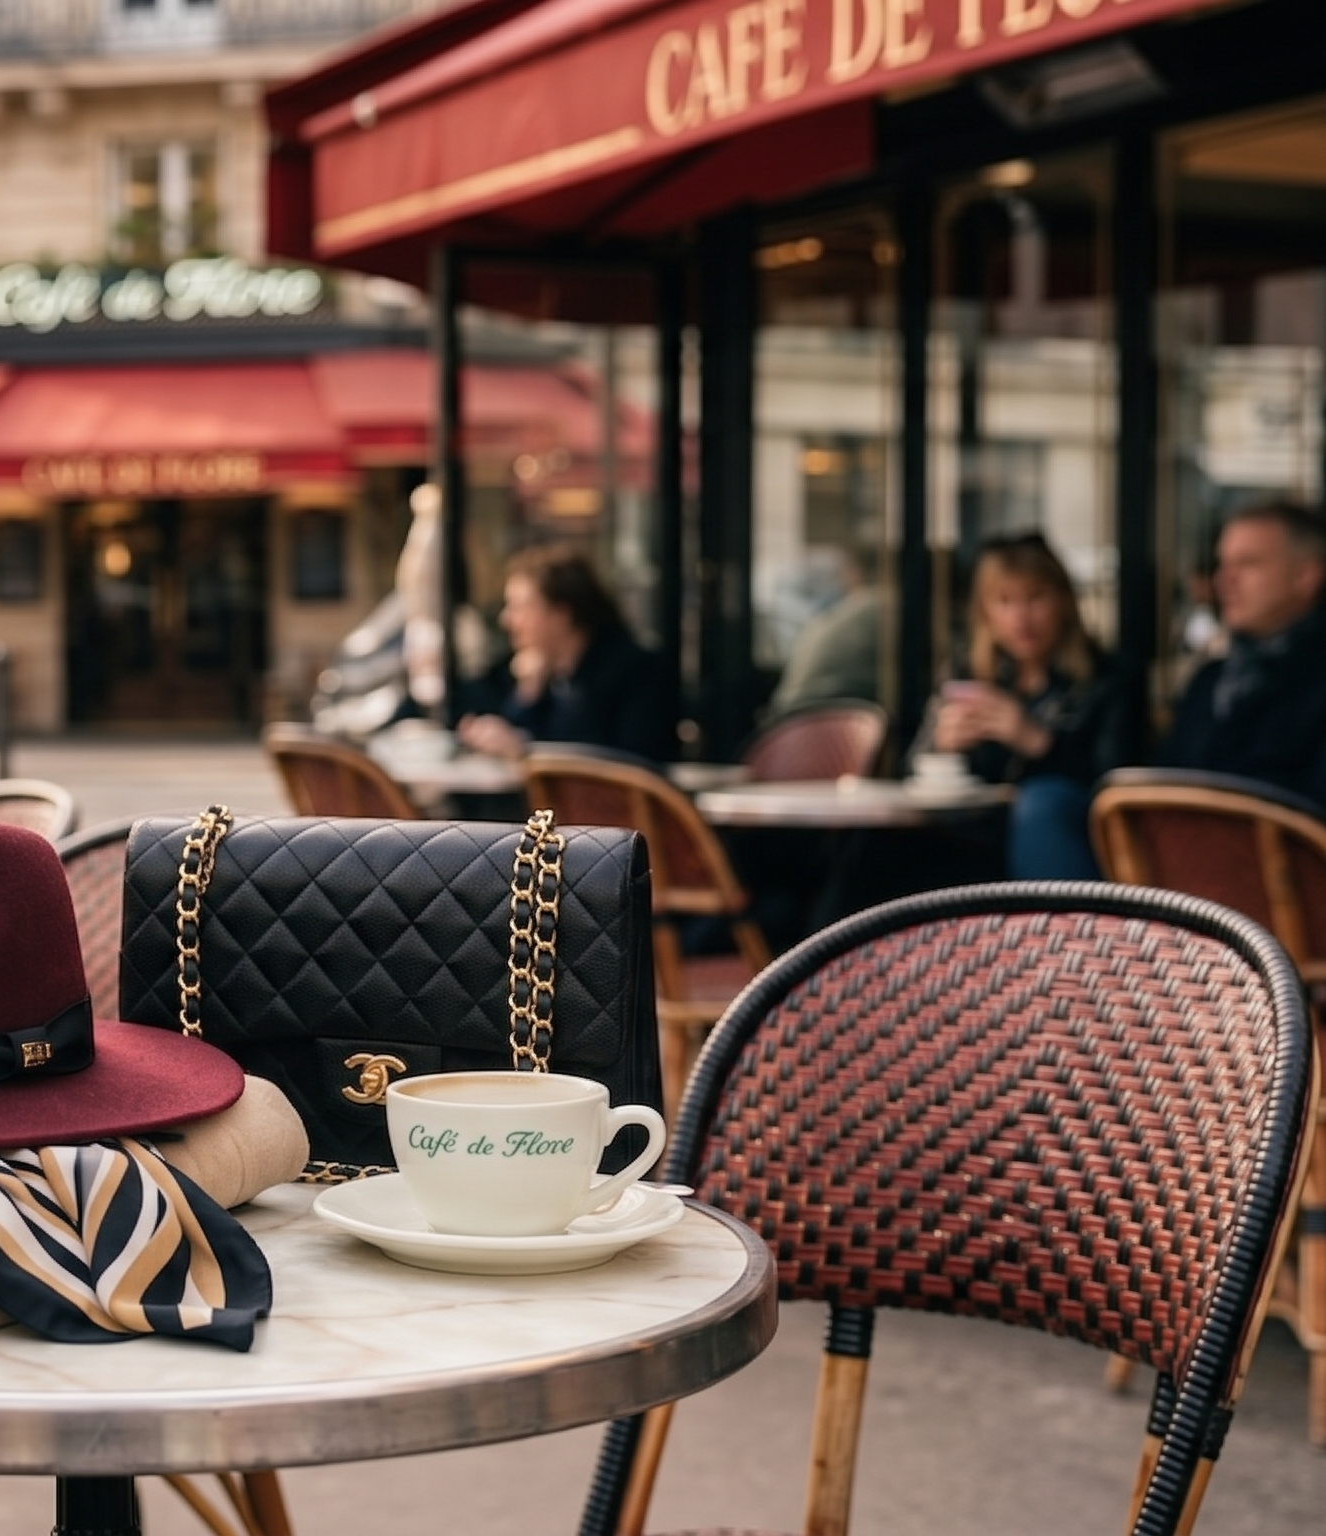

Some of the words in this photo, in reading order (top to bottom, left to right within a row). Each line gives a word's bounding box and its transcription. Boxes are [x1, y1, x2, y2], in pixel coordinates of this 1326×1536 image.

[409, 1125, 459, 1158] Café
[467, 1135, 494, 1155] de
[502, 1131, 574, 1158] Flore
